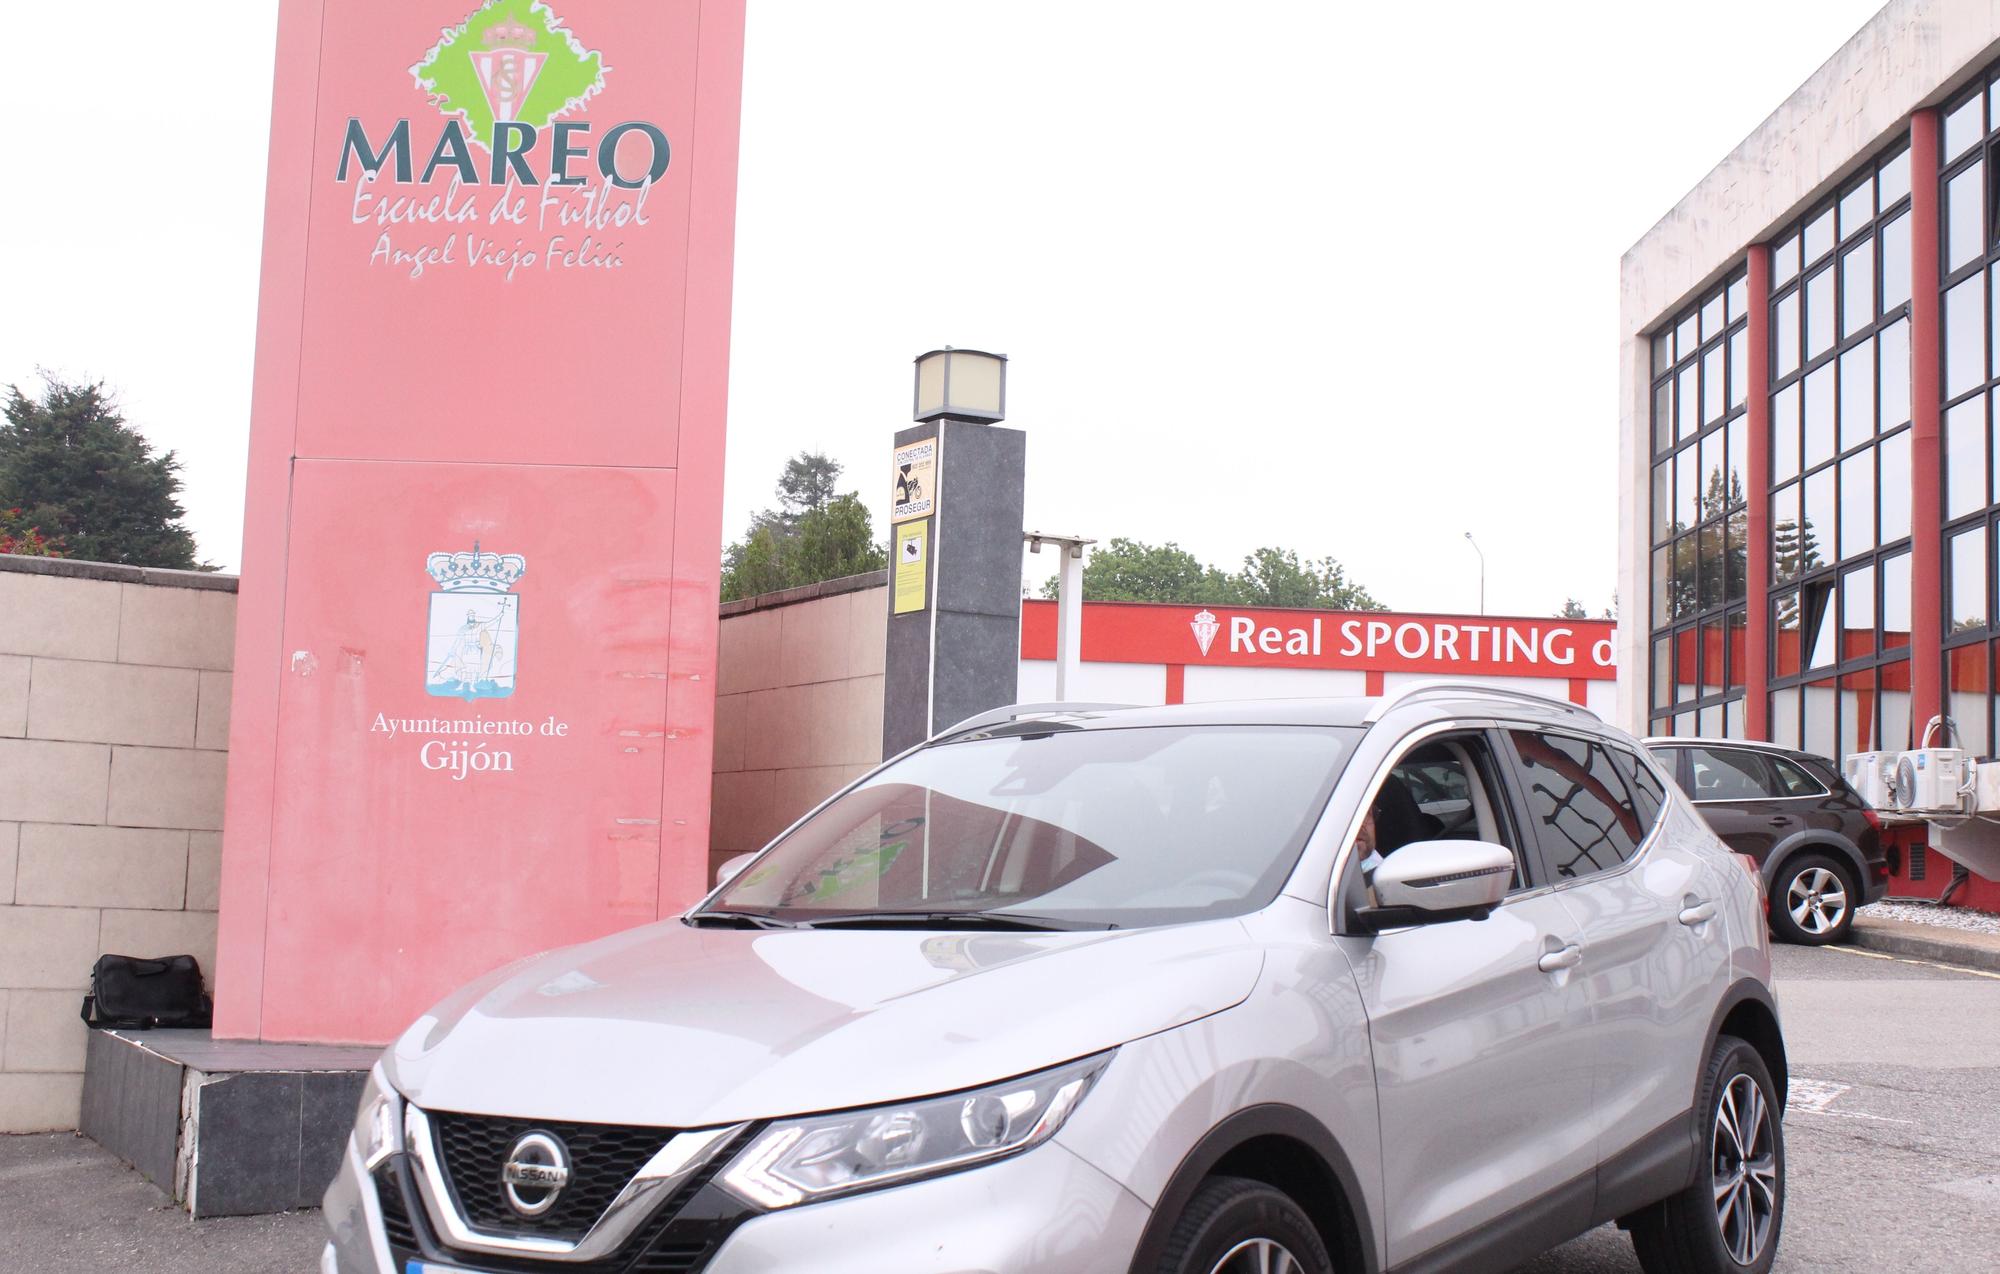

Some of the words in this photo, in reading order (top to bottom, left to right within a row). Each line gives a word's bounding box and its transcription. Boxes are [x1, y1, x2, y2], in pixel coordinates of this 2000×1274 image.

[336, 117, 671, 189] MAREO
[351, 169, 478, 225] Escuela
[489, 176, 527, 225] de
[539, 173, 653, 232] Fútbol
[369, 225, 457, 279] Ángel
[467, 233, 537, 280] Viejo
[897, 445, 932, 461] CONECTADA
[895, 501, 931, 516] PROSEGUR
[1230, 616, 1321, 655] Real
[1339, 620, 1574, 665] SPORTING
[1592, 629, 1617, 666] d
[370, 712, 533, 739] Ayuntamiento
[540, 716, 568, 737] de
[420, 741, 514, 780] Gijón
